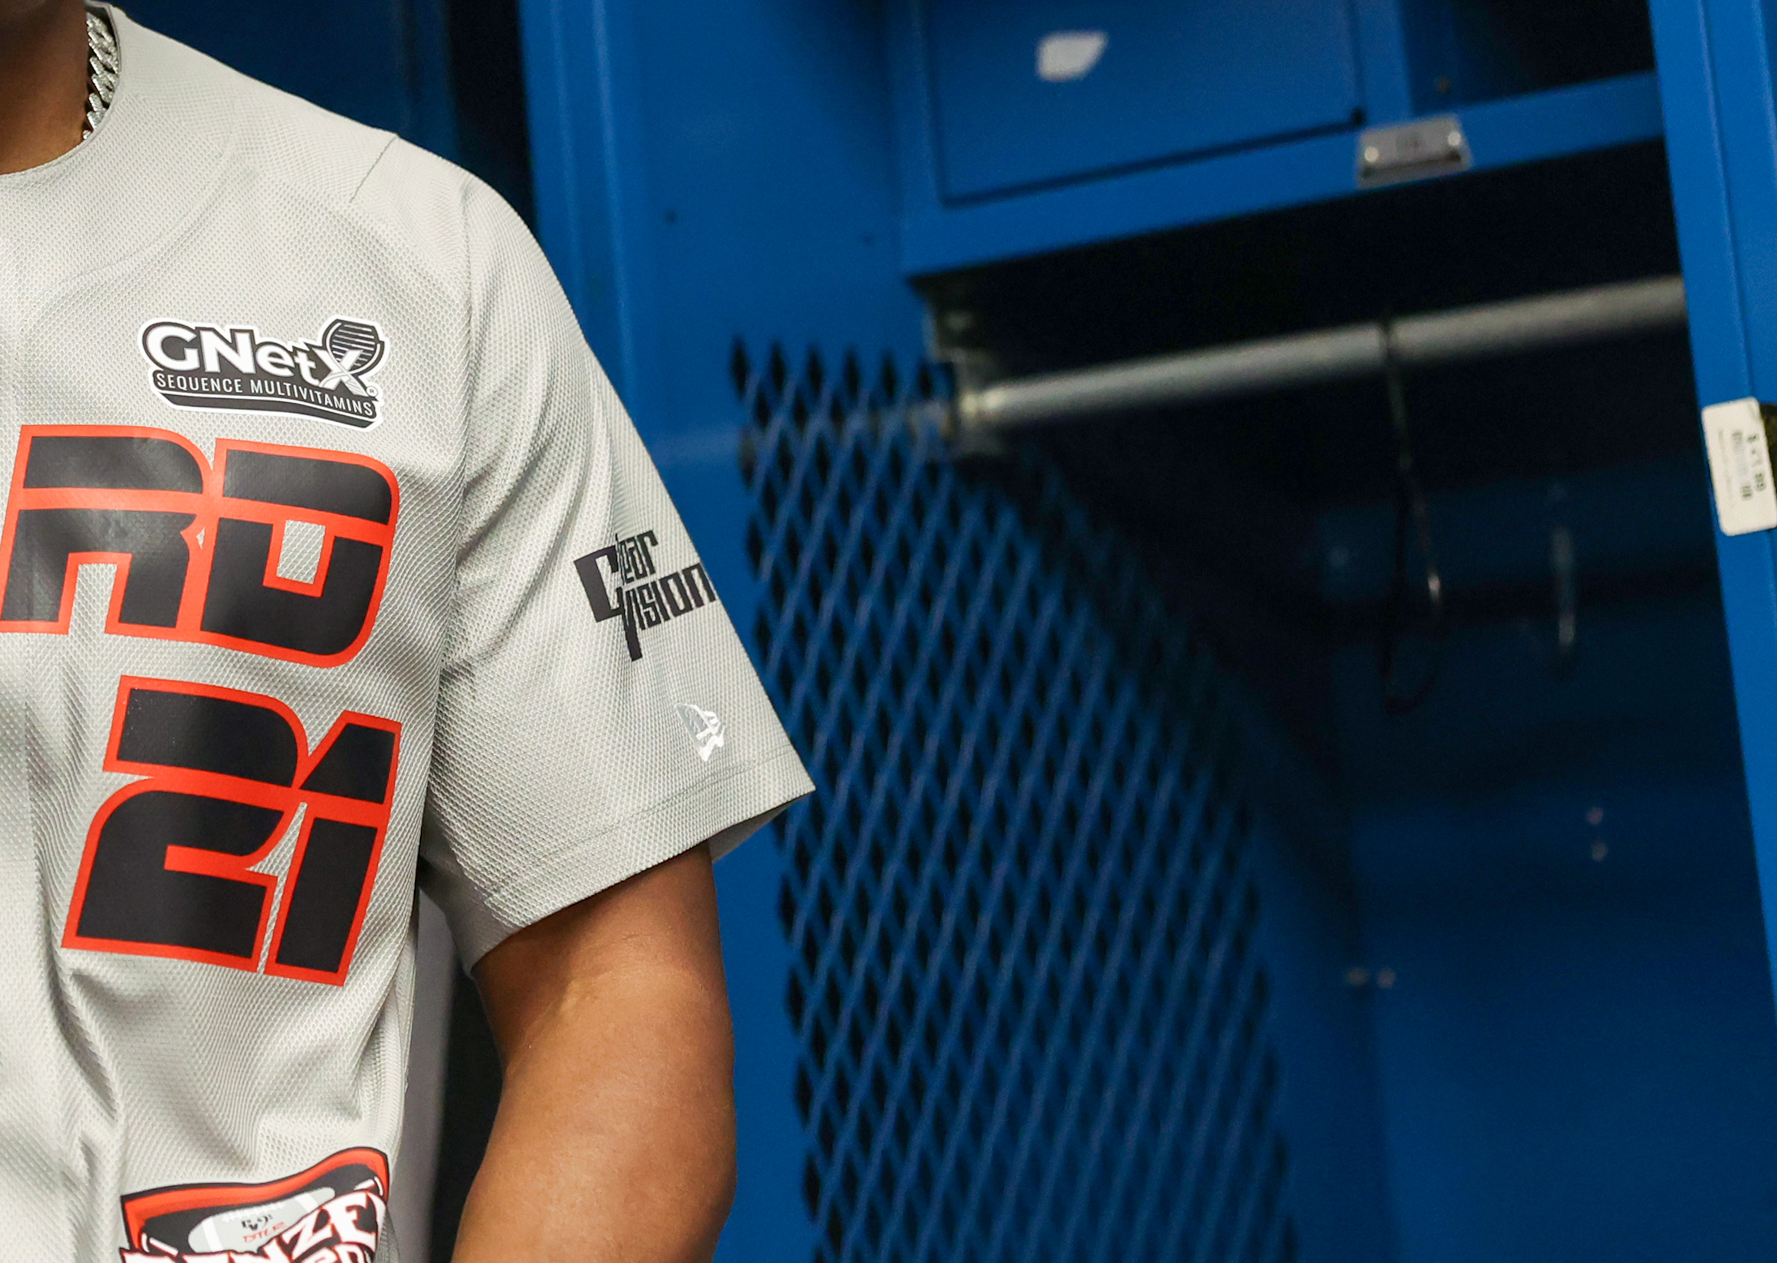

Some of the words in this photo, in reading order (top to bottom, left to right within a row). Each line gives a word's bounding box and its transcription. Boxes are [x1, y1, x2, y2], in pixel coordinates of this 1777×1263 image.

[155, 371, 244, 394] SEQUENCE
[249, 379, 374, 417] MULTIVITAMINS
[60, 674, 402, 987] 21
